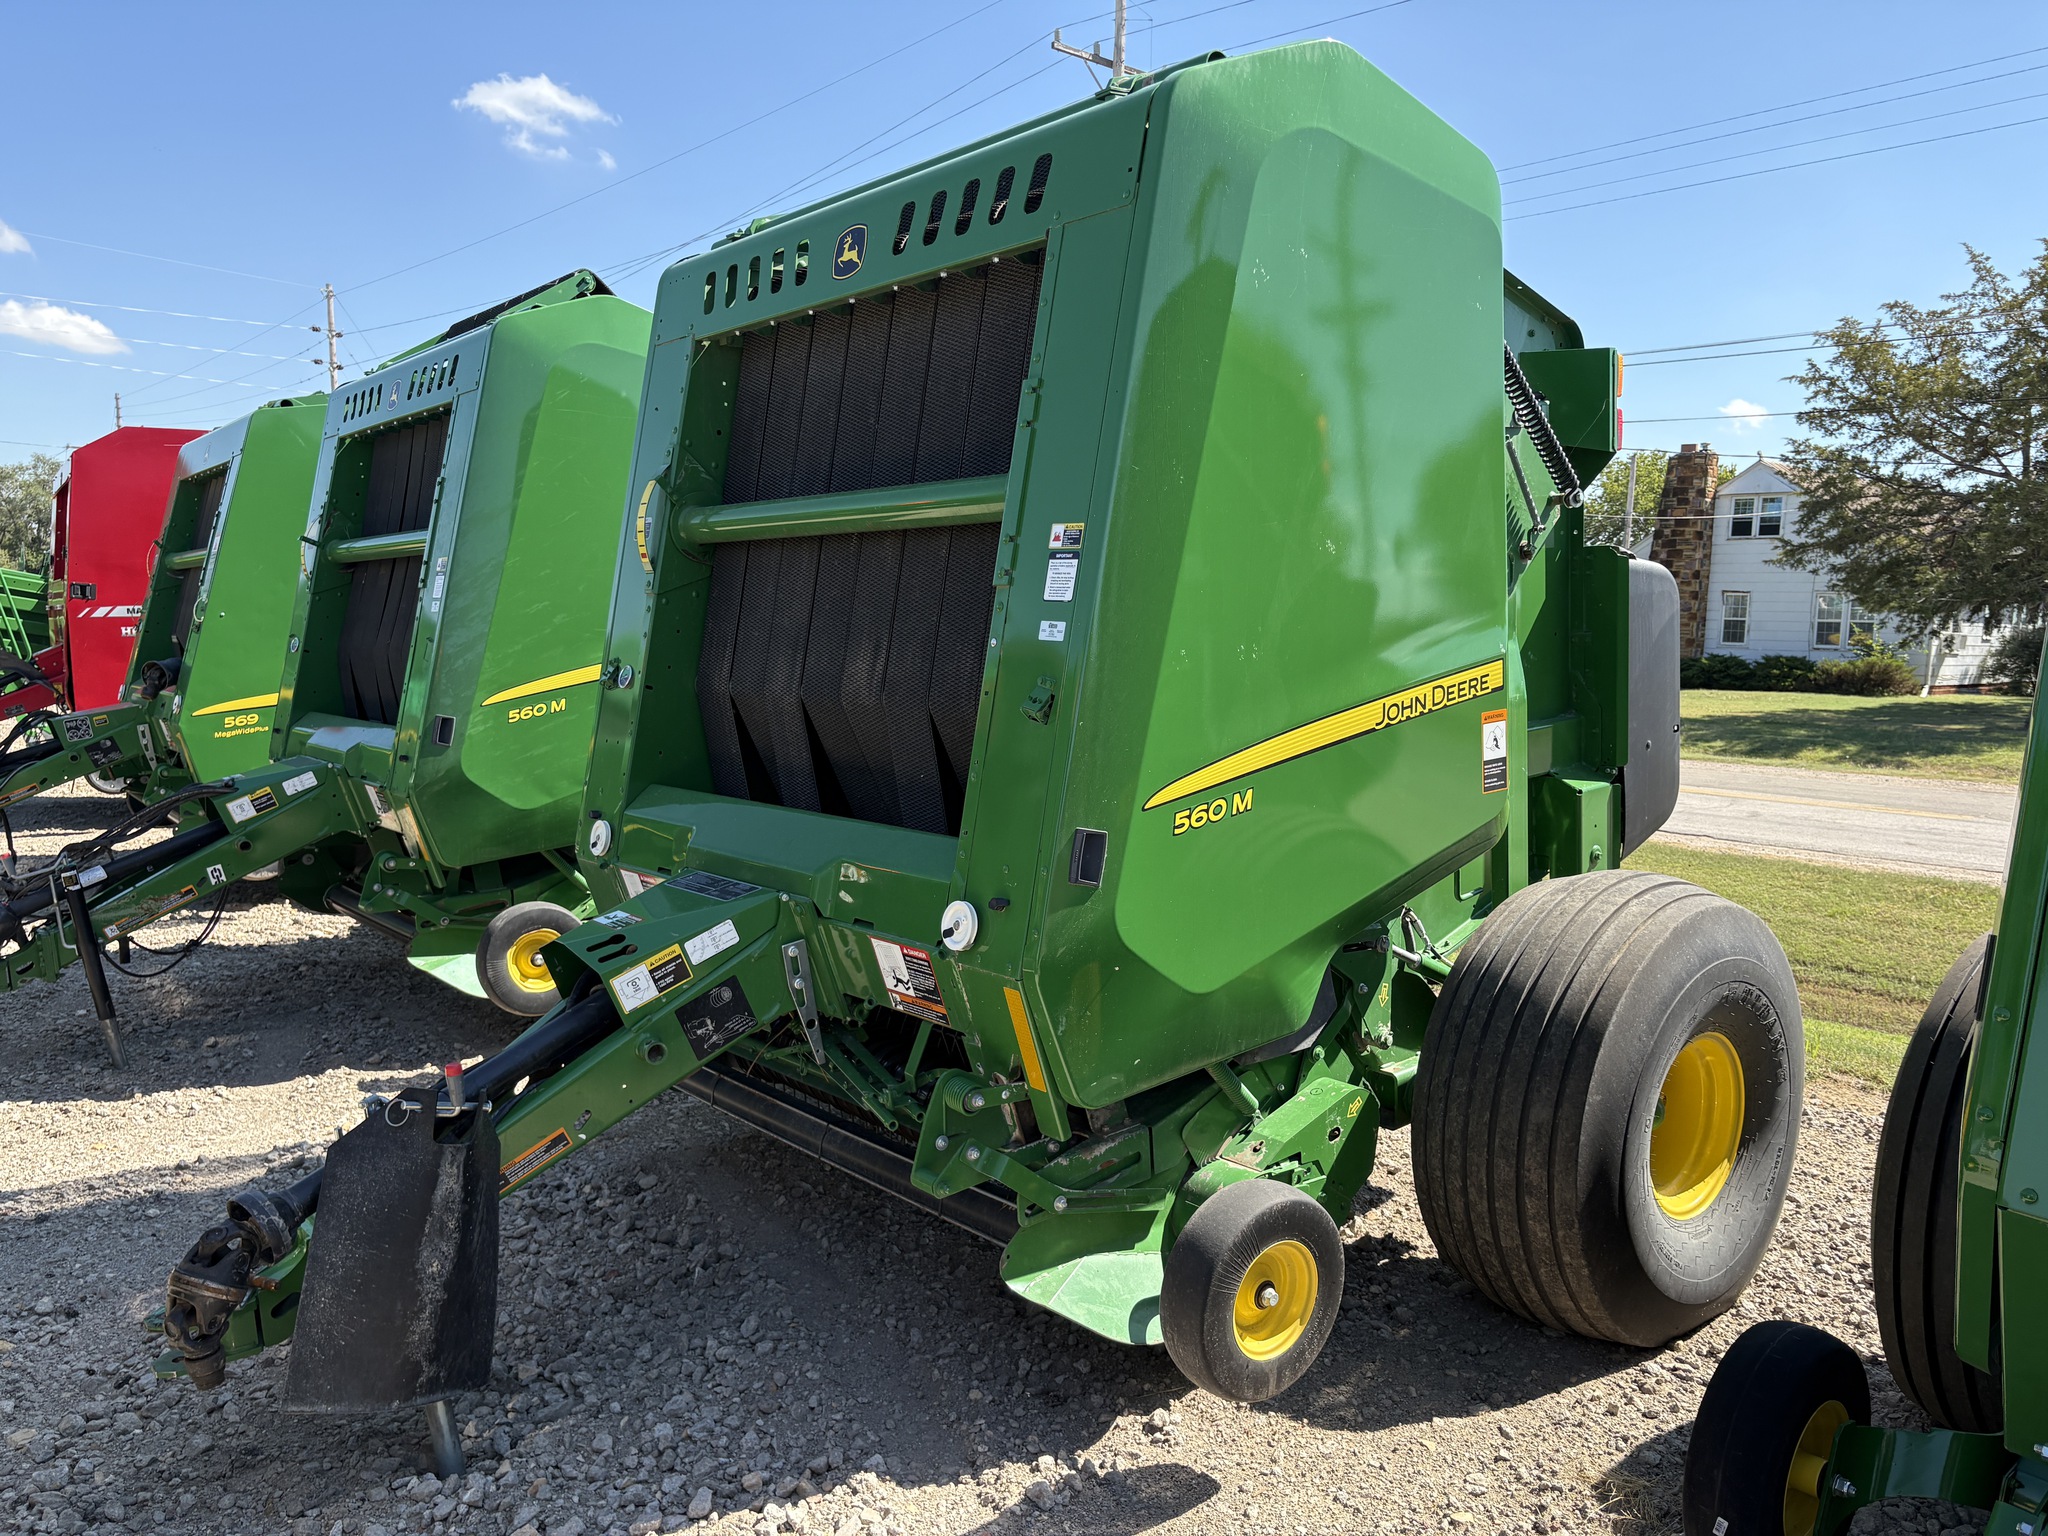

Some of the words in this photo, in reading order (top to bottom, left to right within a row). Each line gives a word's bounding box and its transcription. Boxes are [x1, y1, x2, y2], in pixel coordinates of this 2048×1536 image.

[507, 703, 548, 724] 560
[550, 697, 567, 714] M
[1375, 692, 1427, 727] JOHN
[1431, 673, 1491, 708] DEERE
[223, 713, 260, 729] 569
[213, 725, 270, 739] MegaWidePlus
[1172, 796, 1229, 837] 560
[1230, 786, 1255, 818] M
[654, 949, 677, 964] CAUTION
